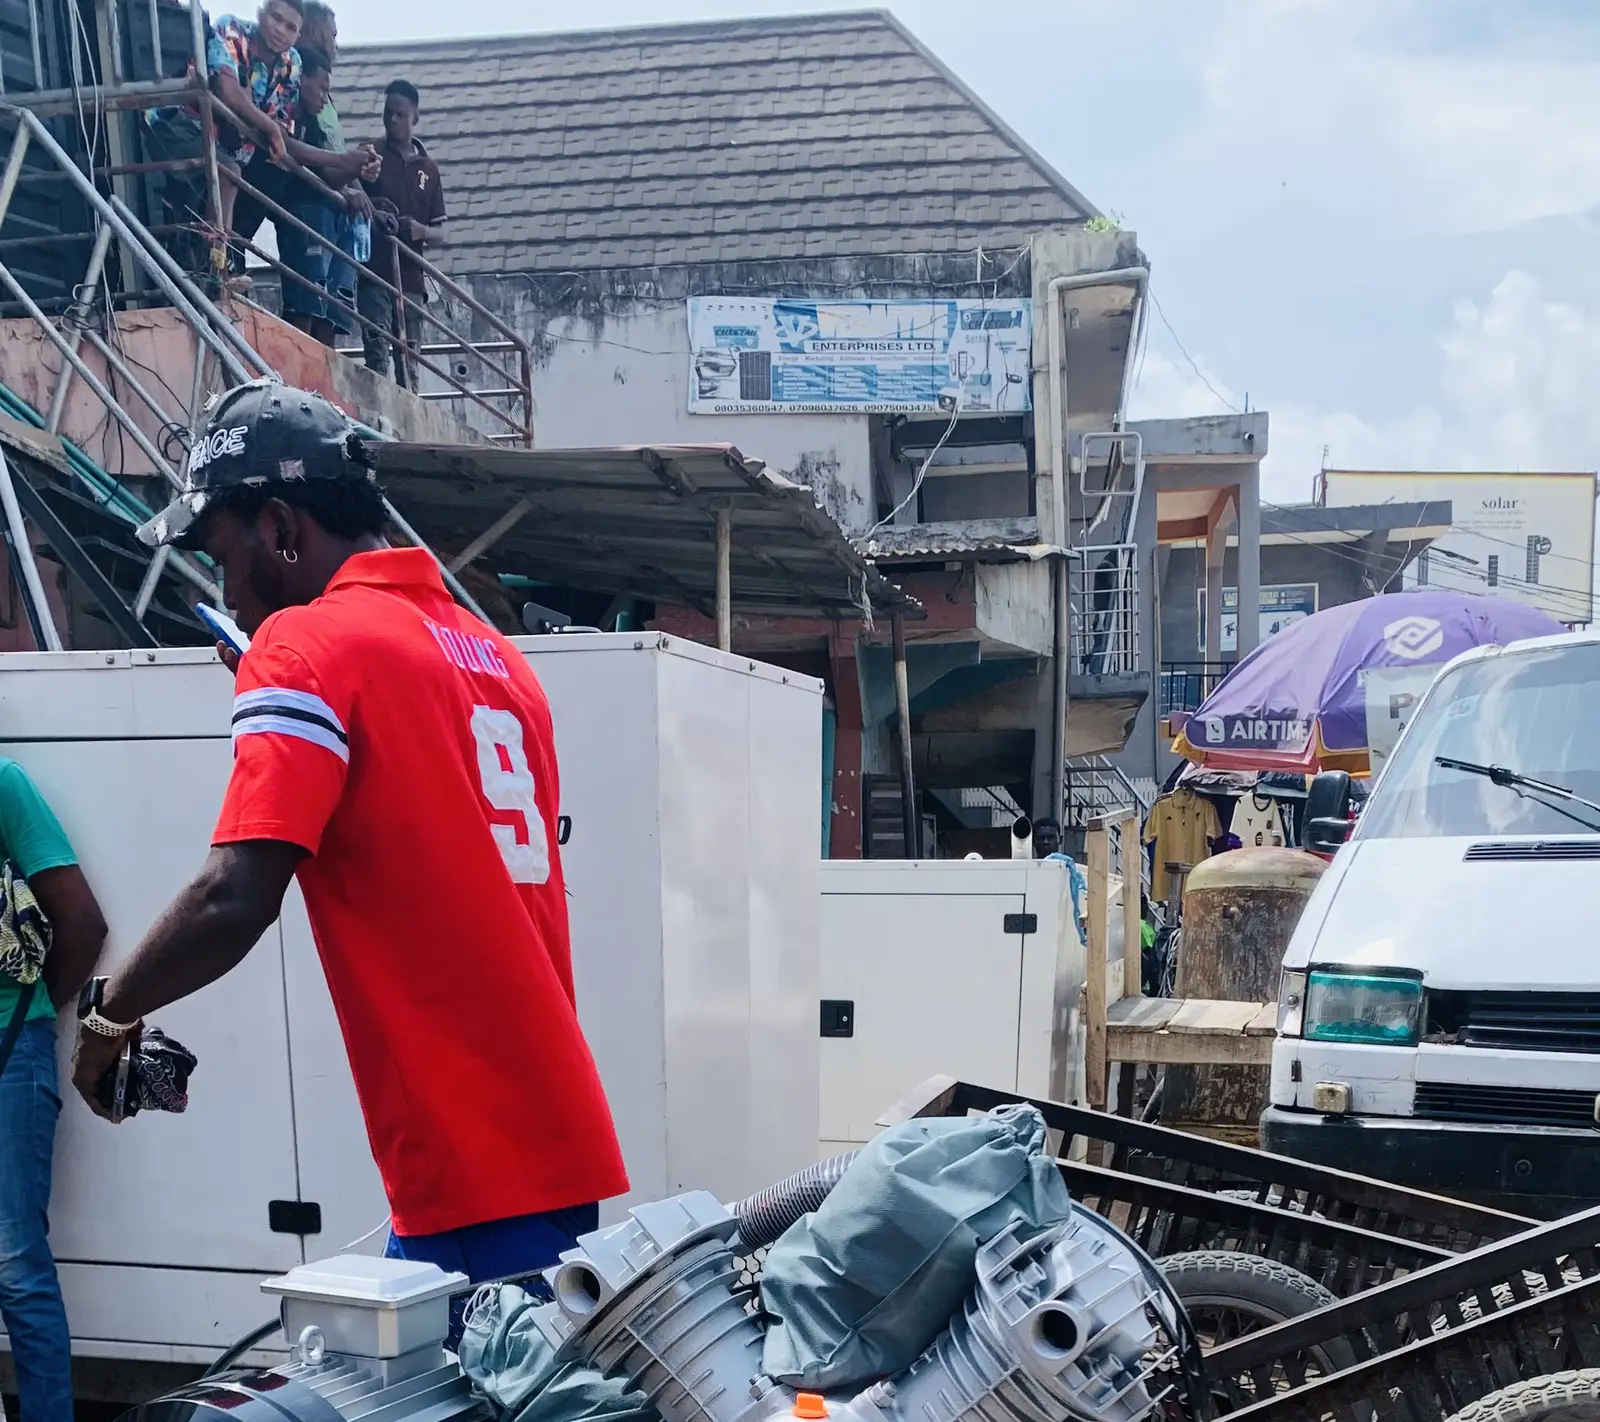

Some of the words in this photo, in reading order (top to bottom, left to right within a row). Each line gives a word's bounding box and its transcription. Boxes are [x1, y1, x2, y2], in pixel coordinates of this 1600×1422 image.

[812, 342, 904, 351] ENTERPRISES
[1482, 496, 1519, 509] solar
[423, 620, 511, 680] YOUNG
[1231, 719, 1308, 742] AIRTIME
[470, 704, 551, 885] 9
